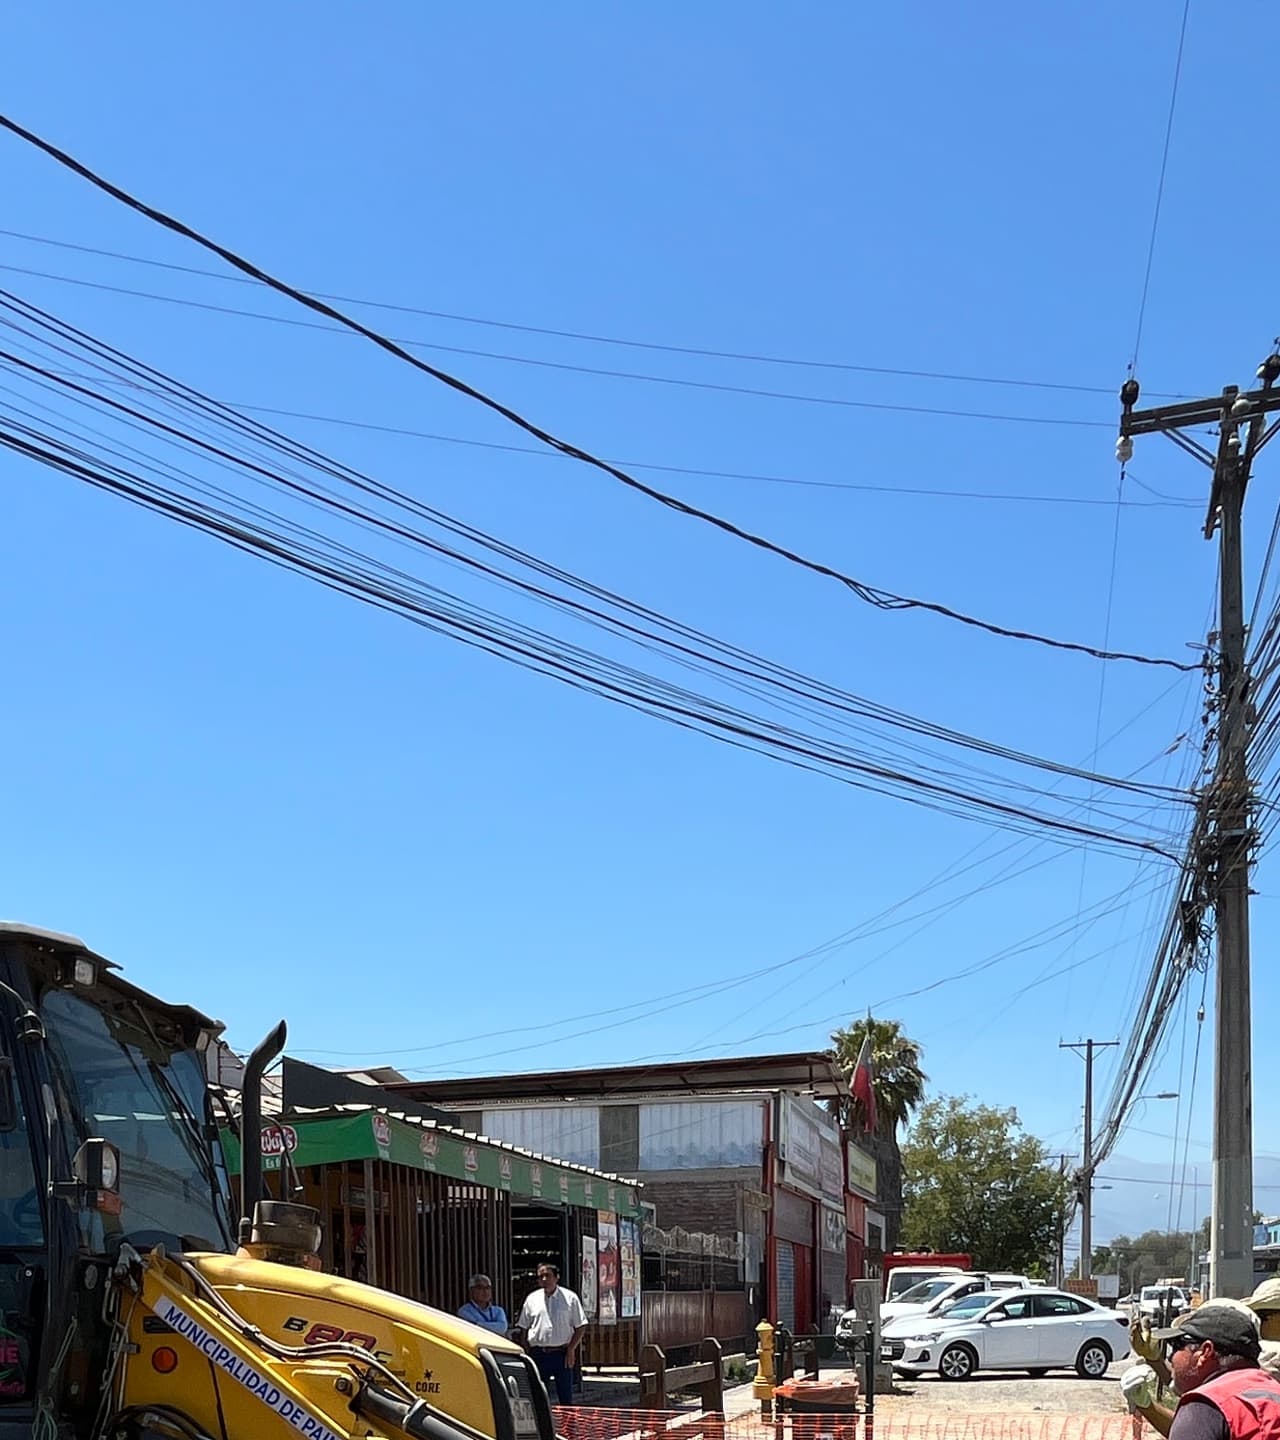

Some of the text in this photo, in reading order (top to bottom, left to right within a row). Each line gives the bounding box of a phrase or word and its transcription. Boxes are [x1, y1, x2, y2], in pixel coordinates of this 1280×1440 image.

[164, 1306, 280, 1406] MUNICIPALIDAD
[279, 1400, 304, 1426] DE
[415, 1382, 440, 1394] CORE
